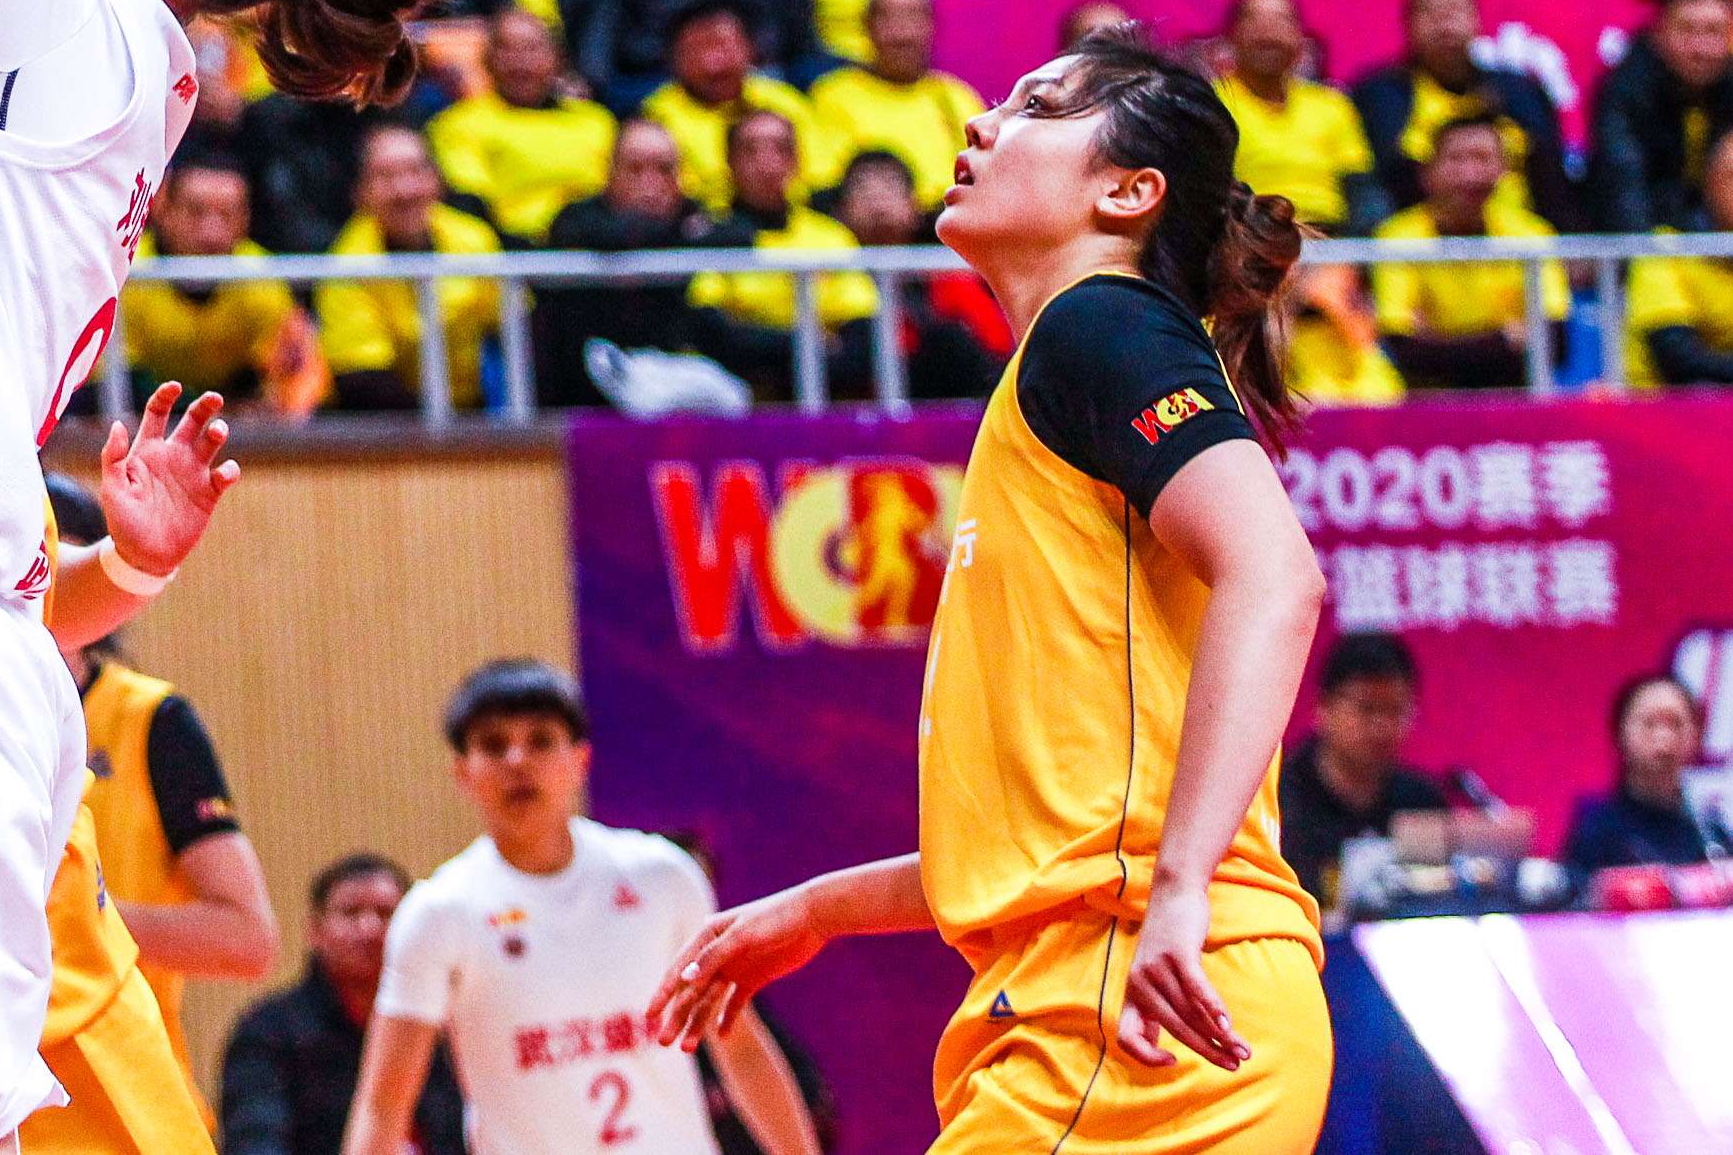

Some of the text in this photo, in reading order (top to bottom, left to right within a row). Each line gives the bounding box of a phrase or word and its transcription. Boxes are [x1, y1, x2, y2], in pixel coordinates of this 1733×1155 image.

[1318, 538, 1619, 632] 篮球联赛
[587, 1071, 637, 1146] 2
